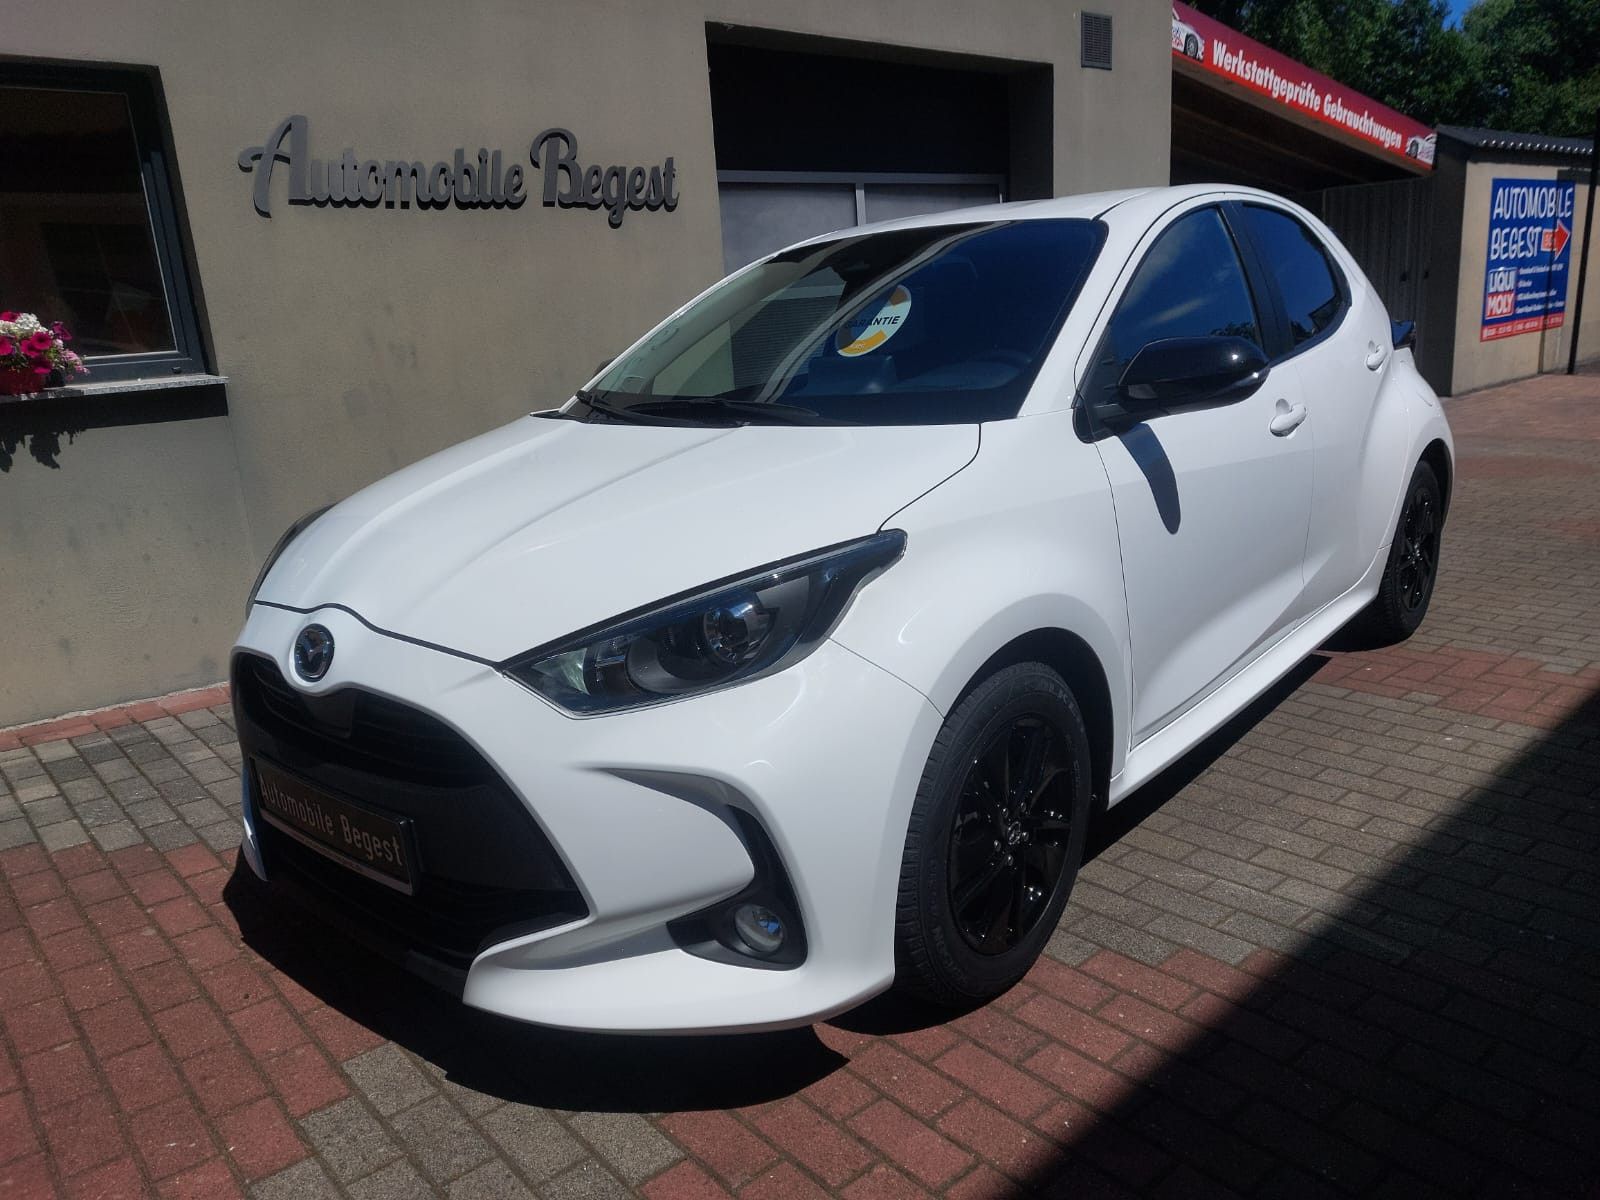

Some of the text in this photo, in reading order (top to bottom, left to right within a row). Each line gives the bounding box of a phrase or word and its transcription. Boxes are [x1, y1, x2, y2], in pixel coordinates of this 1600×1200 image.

[1213, 39, 1403, 149] Werkstattgeprüfte Gebrauchtwagen
[237, 113, 679, 229] Automobile Begest
[1492, 186, 1574, 220] AUTOMOBILE
[1490, 226, 1543, 260] BEGEST
[1488, 269, 1516, 293] LIQUI
[1487, 293, 1514, 317] MOLY
[259, 774, 404, 867] Automobile Begest
